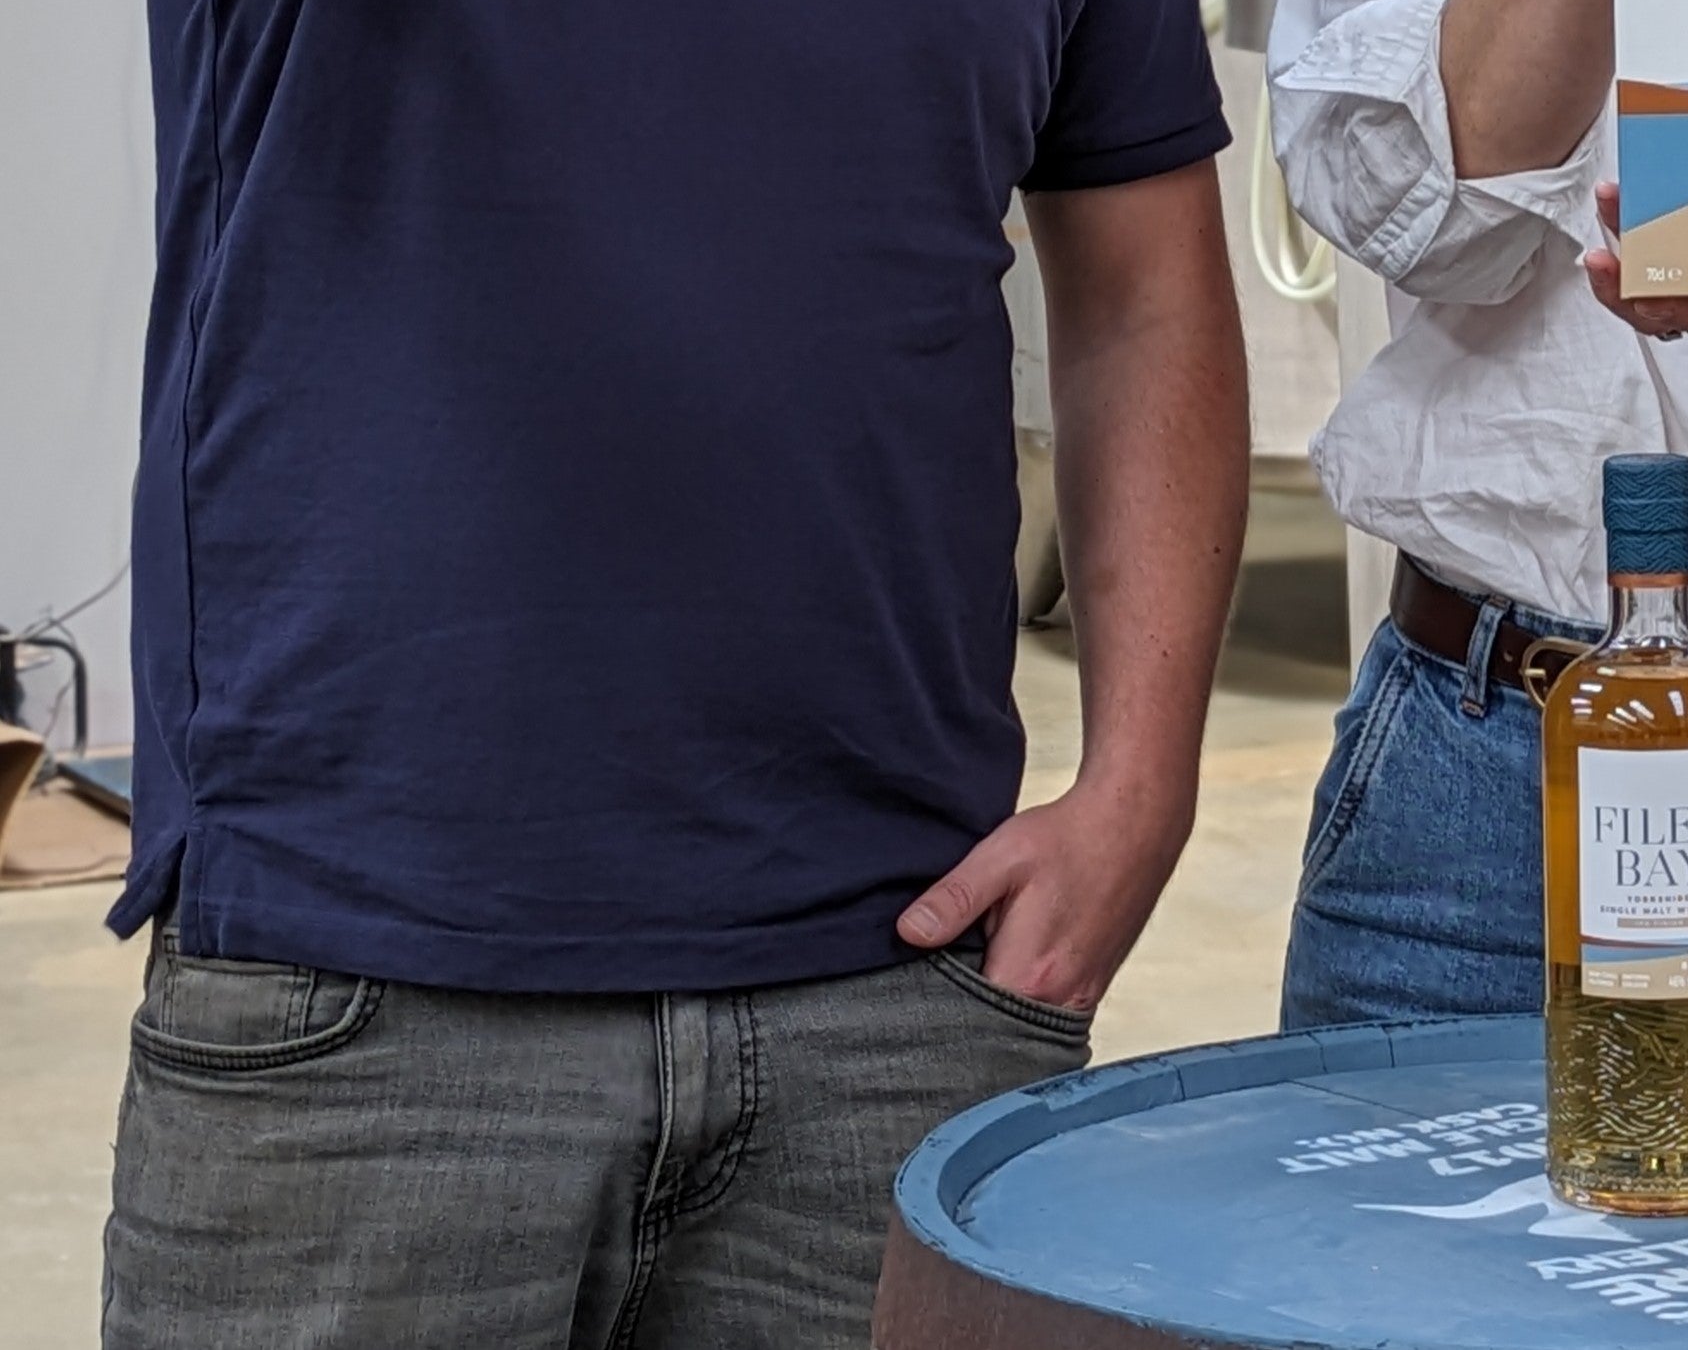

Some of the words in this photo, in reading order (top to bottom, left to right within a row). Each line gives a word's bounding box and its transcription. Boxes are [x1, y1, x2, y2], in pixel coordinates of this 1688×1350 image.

[1600, 904, 1636, 915] SINGLE
[1643, 905, 1671, 915] MALT
[1398, 1103, 1539, 1134] CASK
[1277, 1138, 1436, 1175] MALT
